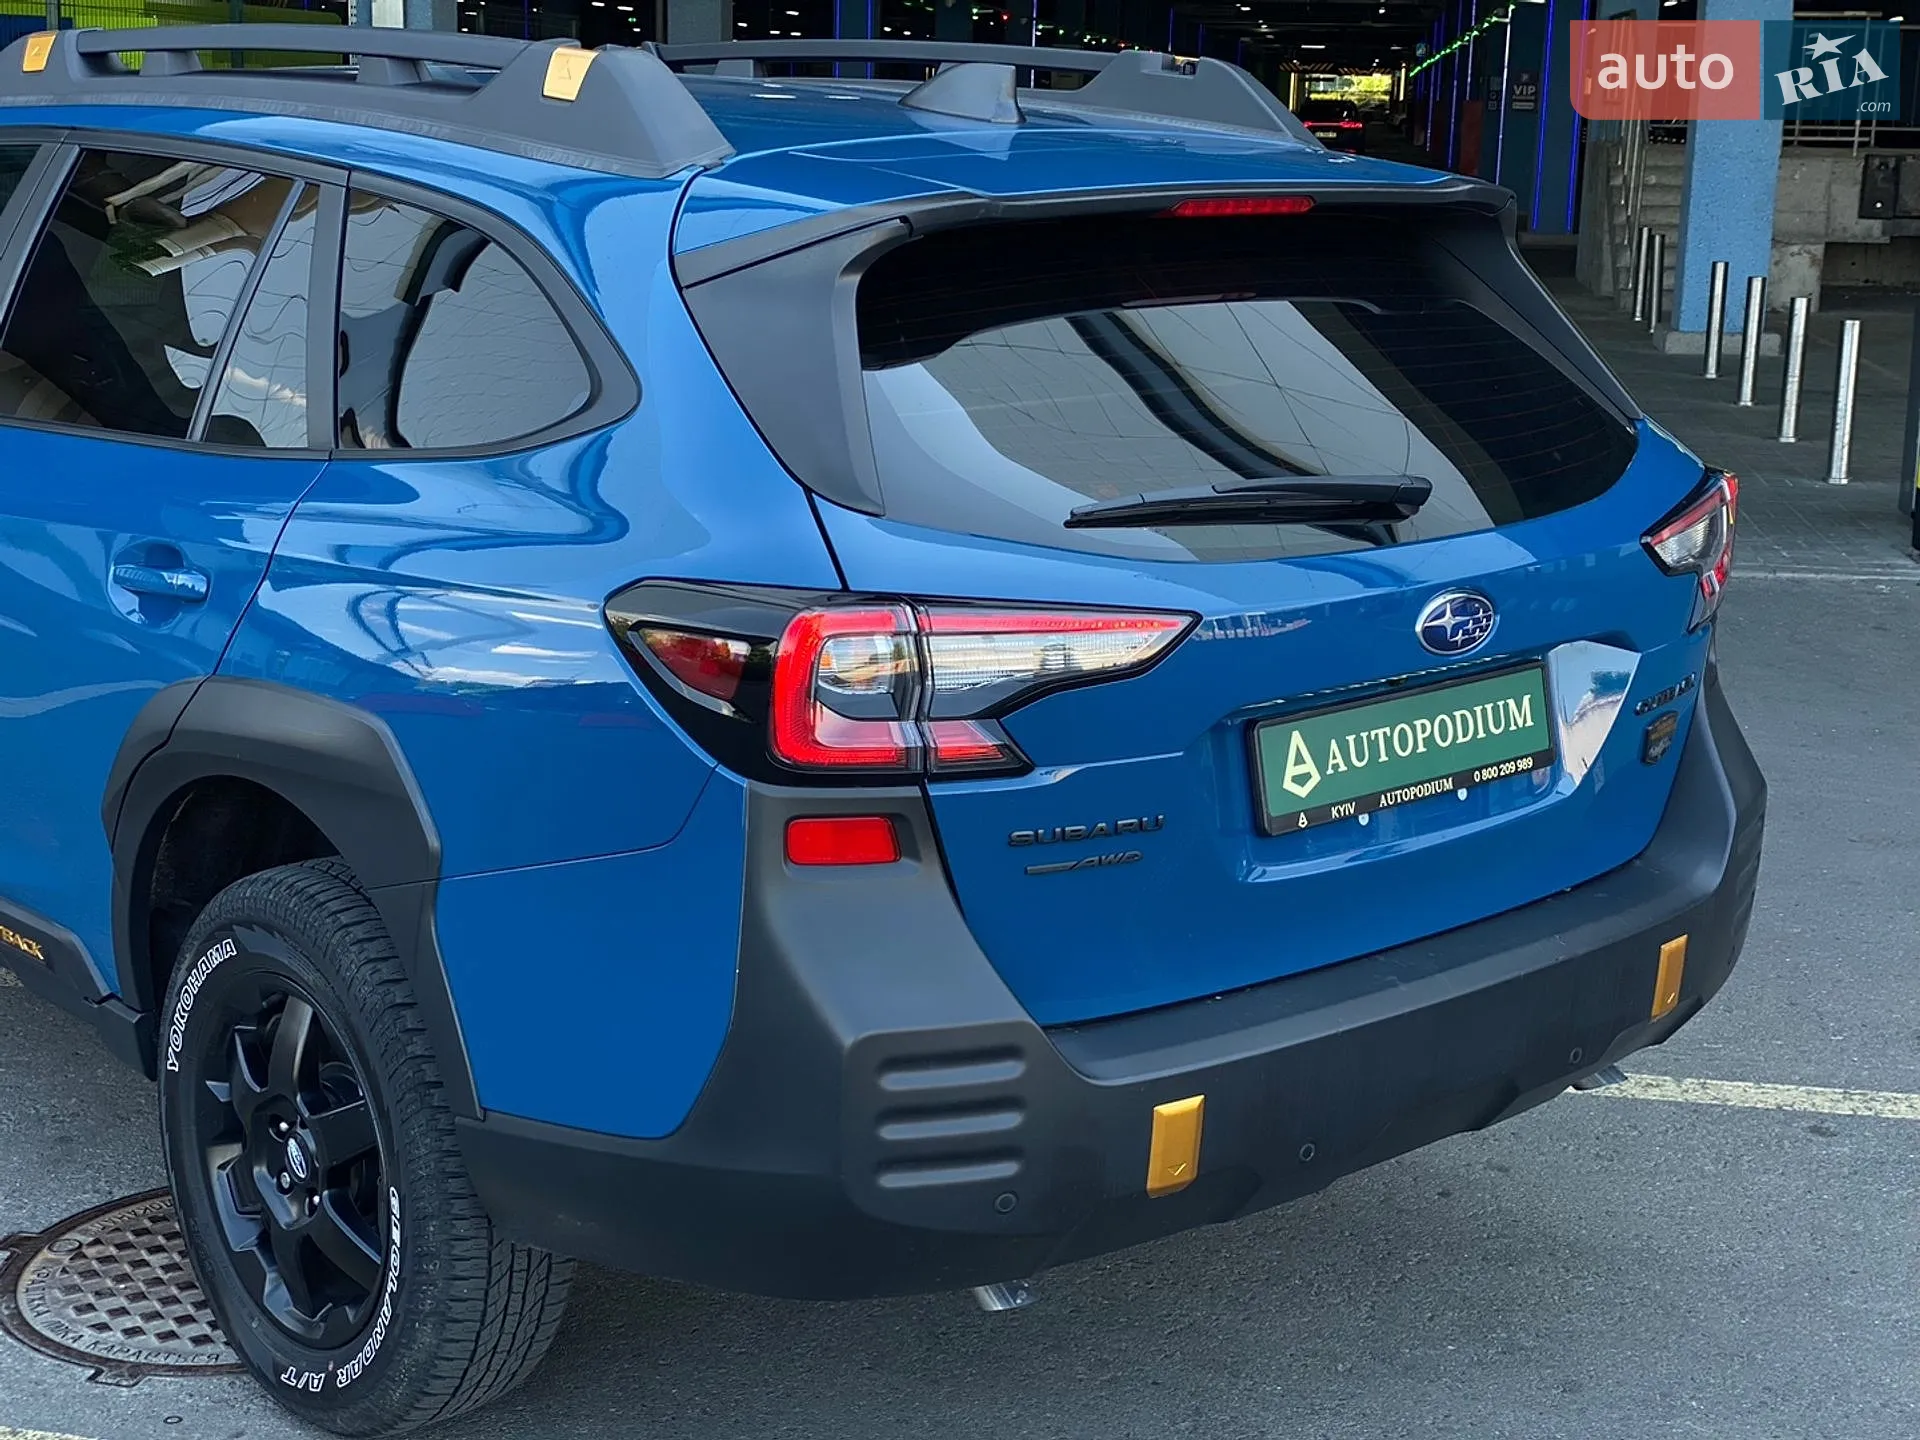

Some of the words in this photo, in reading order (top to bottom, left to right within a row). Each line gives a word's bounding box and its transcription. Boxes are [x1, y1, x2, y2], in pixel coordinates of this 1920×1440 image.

[1513, 85, 1536, 95] VIP
[1326, 694, 1534, 775] AUTOPODIUM
[1331, 802, 1356, 819] KYIV
[1379, 777, 1454, 808] AUTOPODIUM
[1473, 770, 1480, 782] 0
[1481, 765, 1499, 781] 800
[1499, 761, 1515, 776] 209
[1516, 756, 1533, 771] 989
[1009, 814, 1164, 847] SUBARU
[1070, 850, 1143, 871] AWD
[0, 925, 45, 960] BACK
[167, 938, 237, 1072] YOKOHAMA
[336, 1186, 401, 1388] GEOLANDAR
[281, 1366, 325, 1392] A/T
